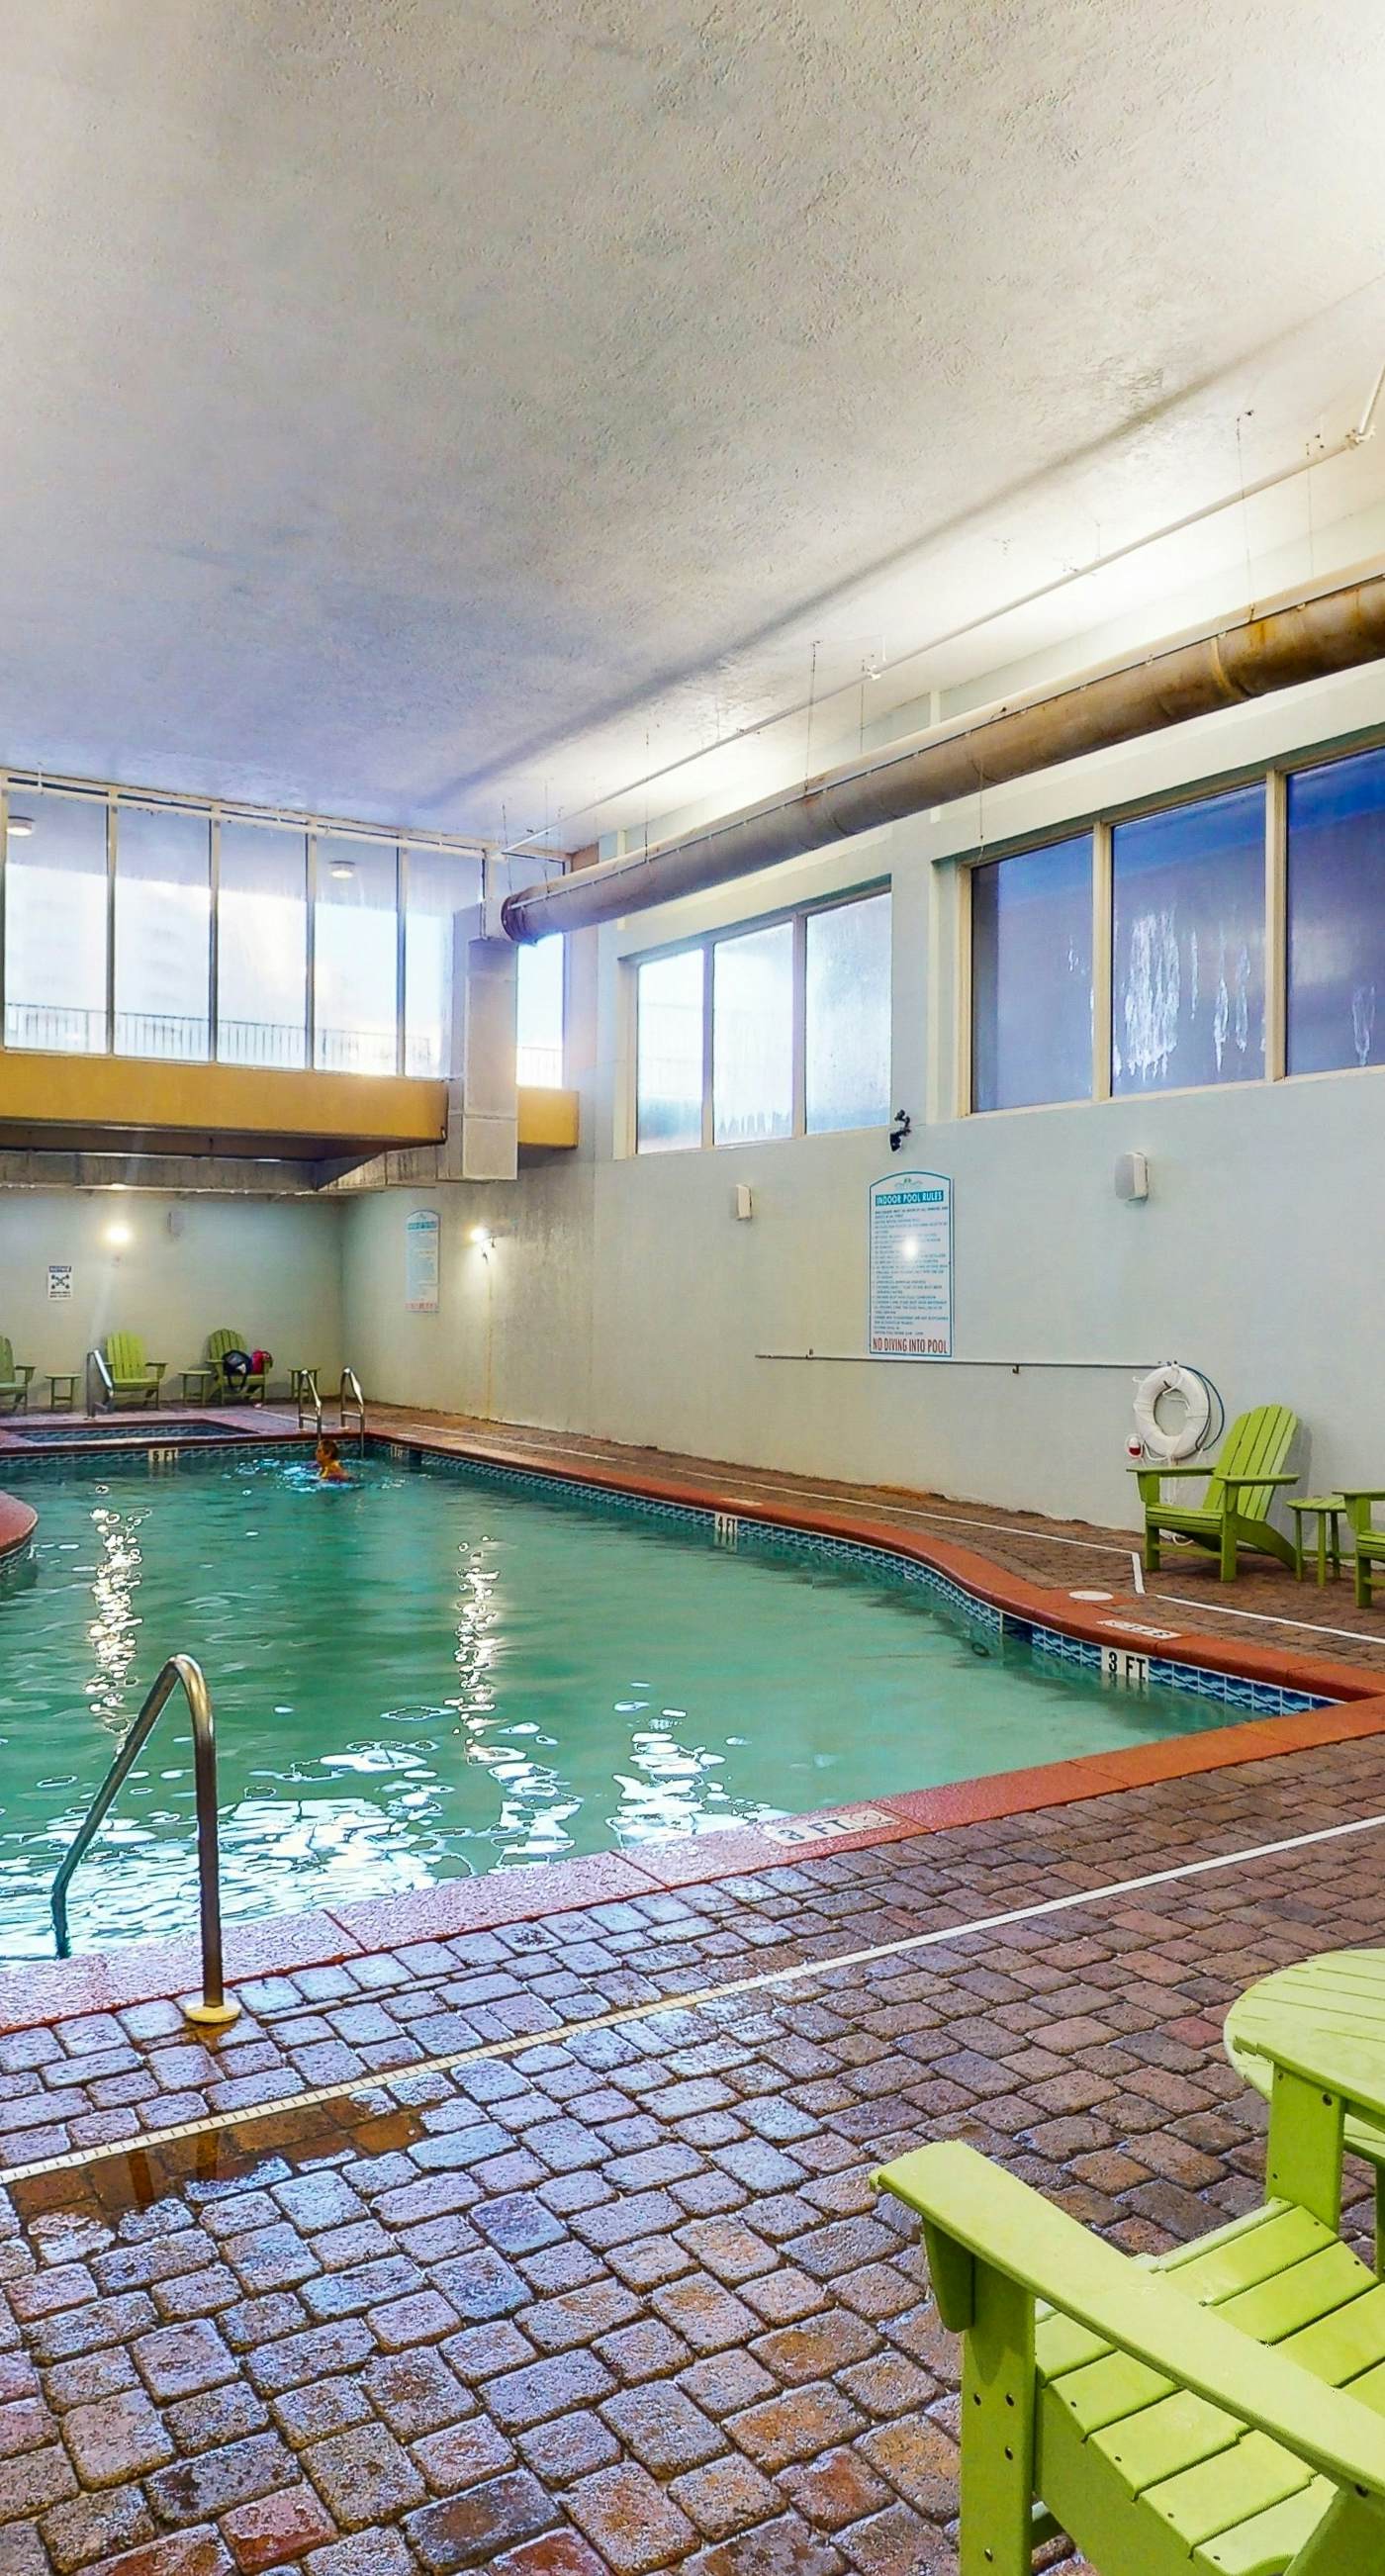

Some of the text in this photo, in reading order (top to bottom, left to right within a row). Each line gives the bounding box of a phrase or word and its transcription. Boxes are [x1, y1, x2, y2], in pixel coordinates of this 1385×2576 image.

[877, 1191, 942, 1205] INDOOR POOL RULES
[873, 1336, 948, 1353] NO DIVING INTO POOL
[152, 1450, 159, 1461] 5
[1108, 1651, 1118, 1673] 3
[778, 1829, 805, 1841] 3
